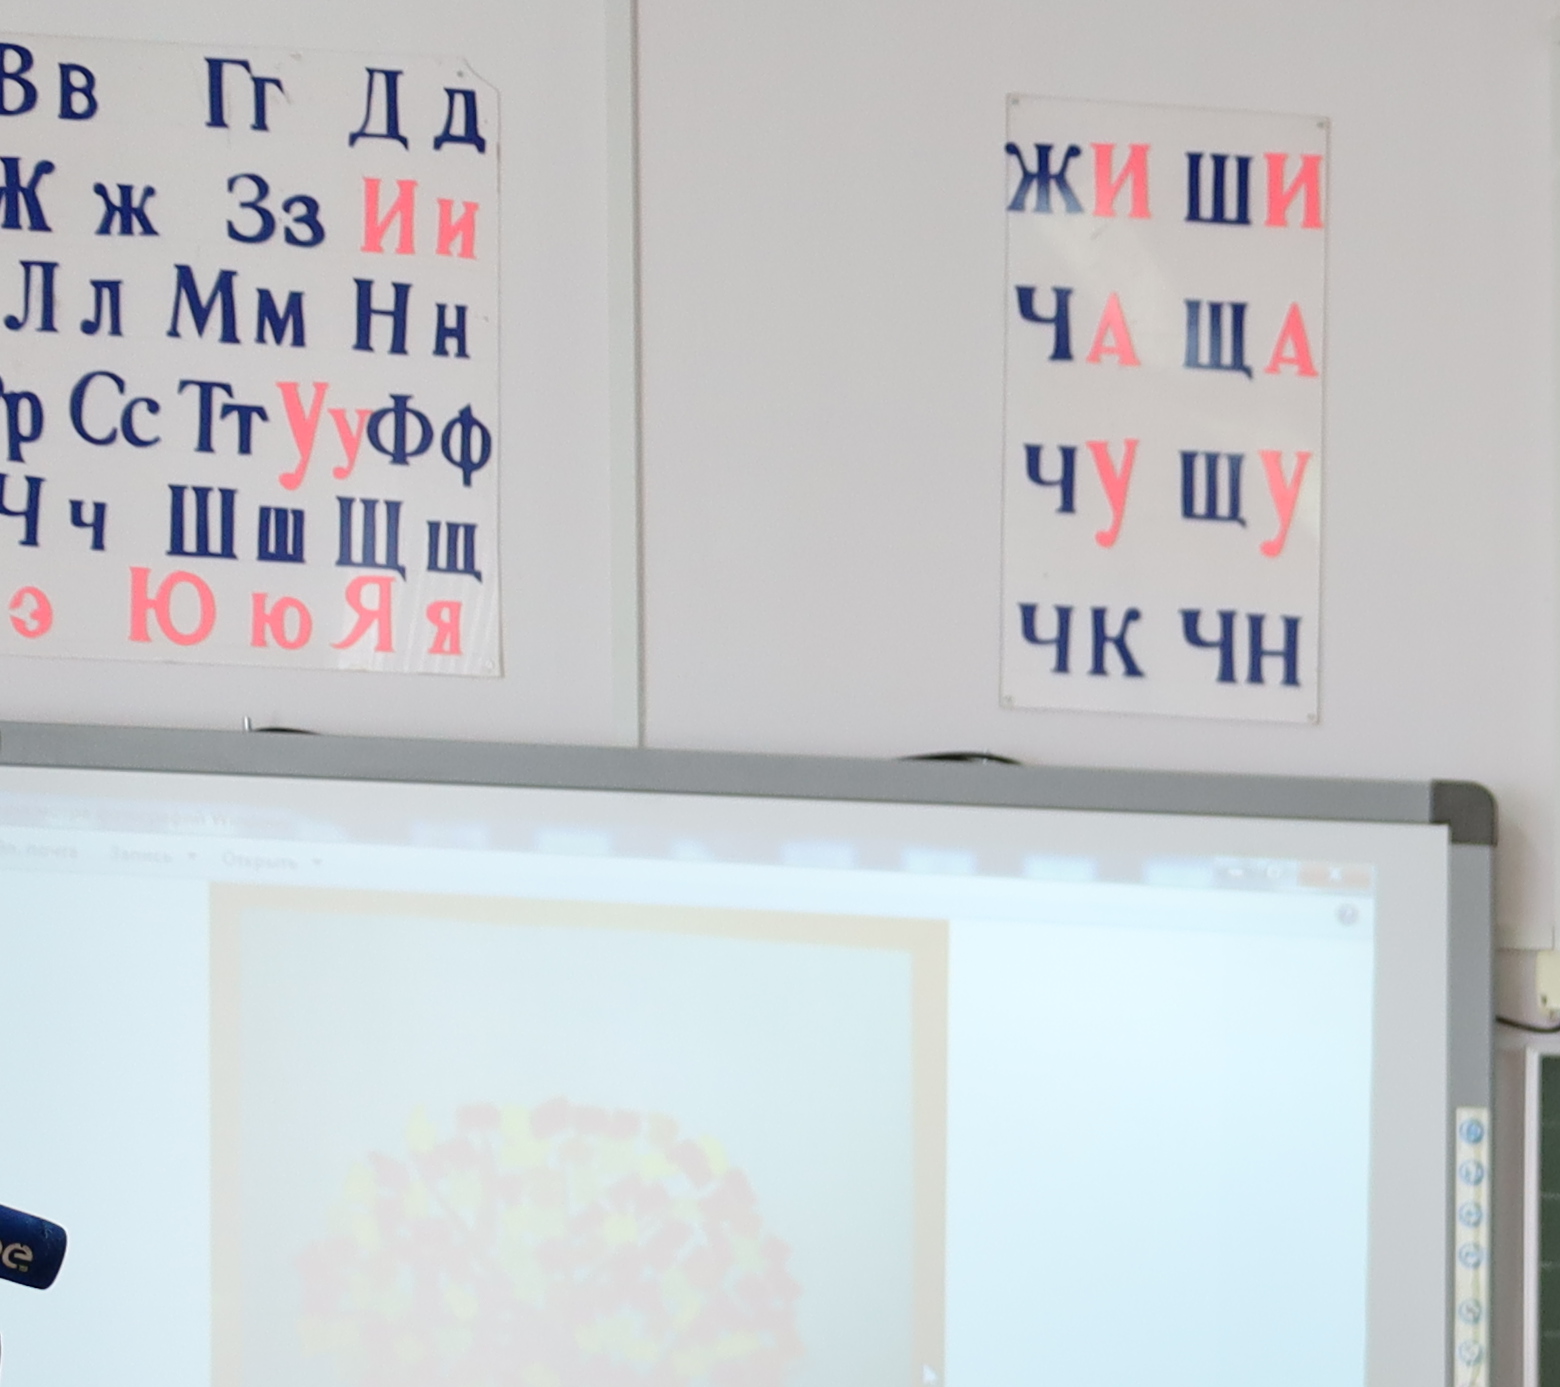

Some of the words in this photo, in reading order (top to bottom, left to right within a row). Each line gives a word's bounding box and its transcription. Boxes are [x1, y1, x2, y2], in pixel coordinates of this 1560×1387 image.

[1005, 142, 1152, 219] ЖИ
[1185, 151, 1324, 230] ШИ
[1015, 285, 1141, 367] ЧА
[1183, 298, 1319, 381] ЩА
[1023, 438, 1140, 549] ЧУ
[1179, 449, 1313, 559] ЩУ
[1017, 601, 1145, 678] ЧК
[1178, 608, 1302, 687] ЧН
